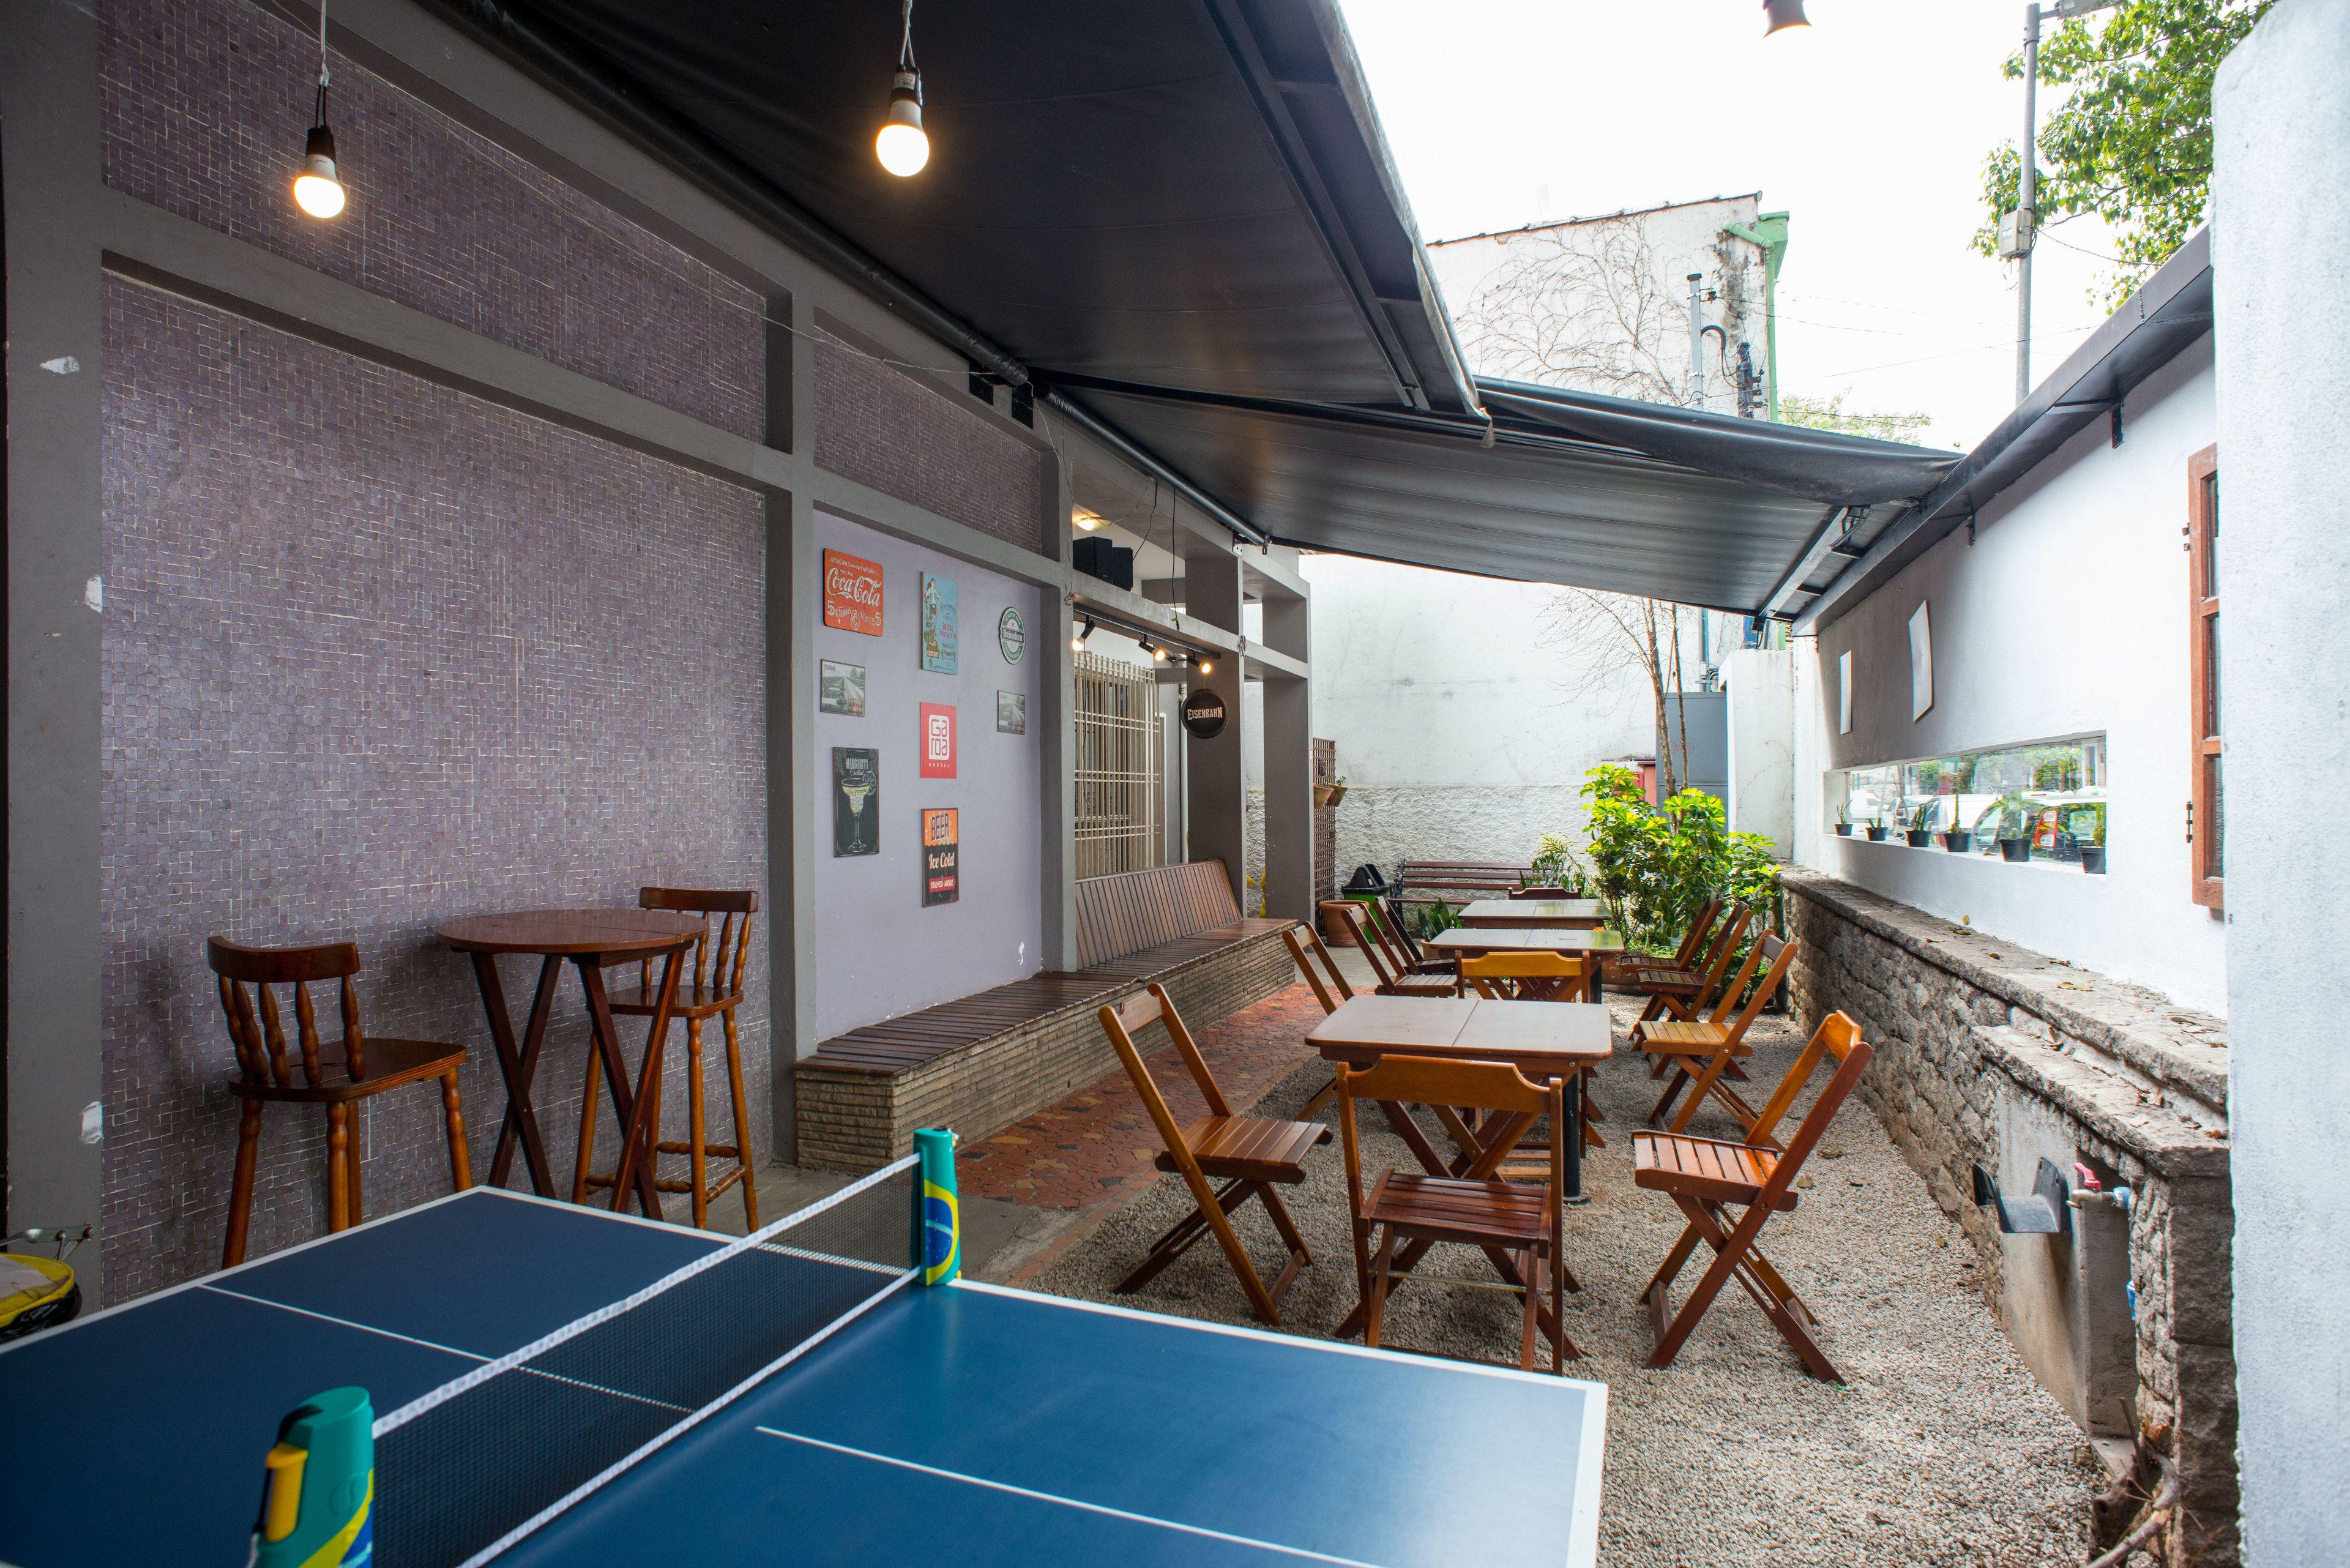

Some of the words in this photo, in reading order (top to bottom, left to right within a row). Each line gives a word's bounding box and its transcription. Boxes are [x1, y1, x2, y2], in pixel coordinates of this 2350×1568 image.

[830, 556, 851, 568] DELICIOUS
[1003, 629, 1023, 642] Heineken
[846, 758, 869, 770] MARGARITA
[931, 813, 950, 842] BEER
[928, 853, 939, 870] Ice
[940, 852, 955, 868] Cold
[930, 879, 944, 889] SERVED
[944, 878, 954, 887] HERE
